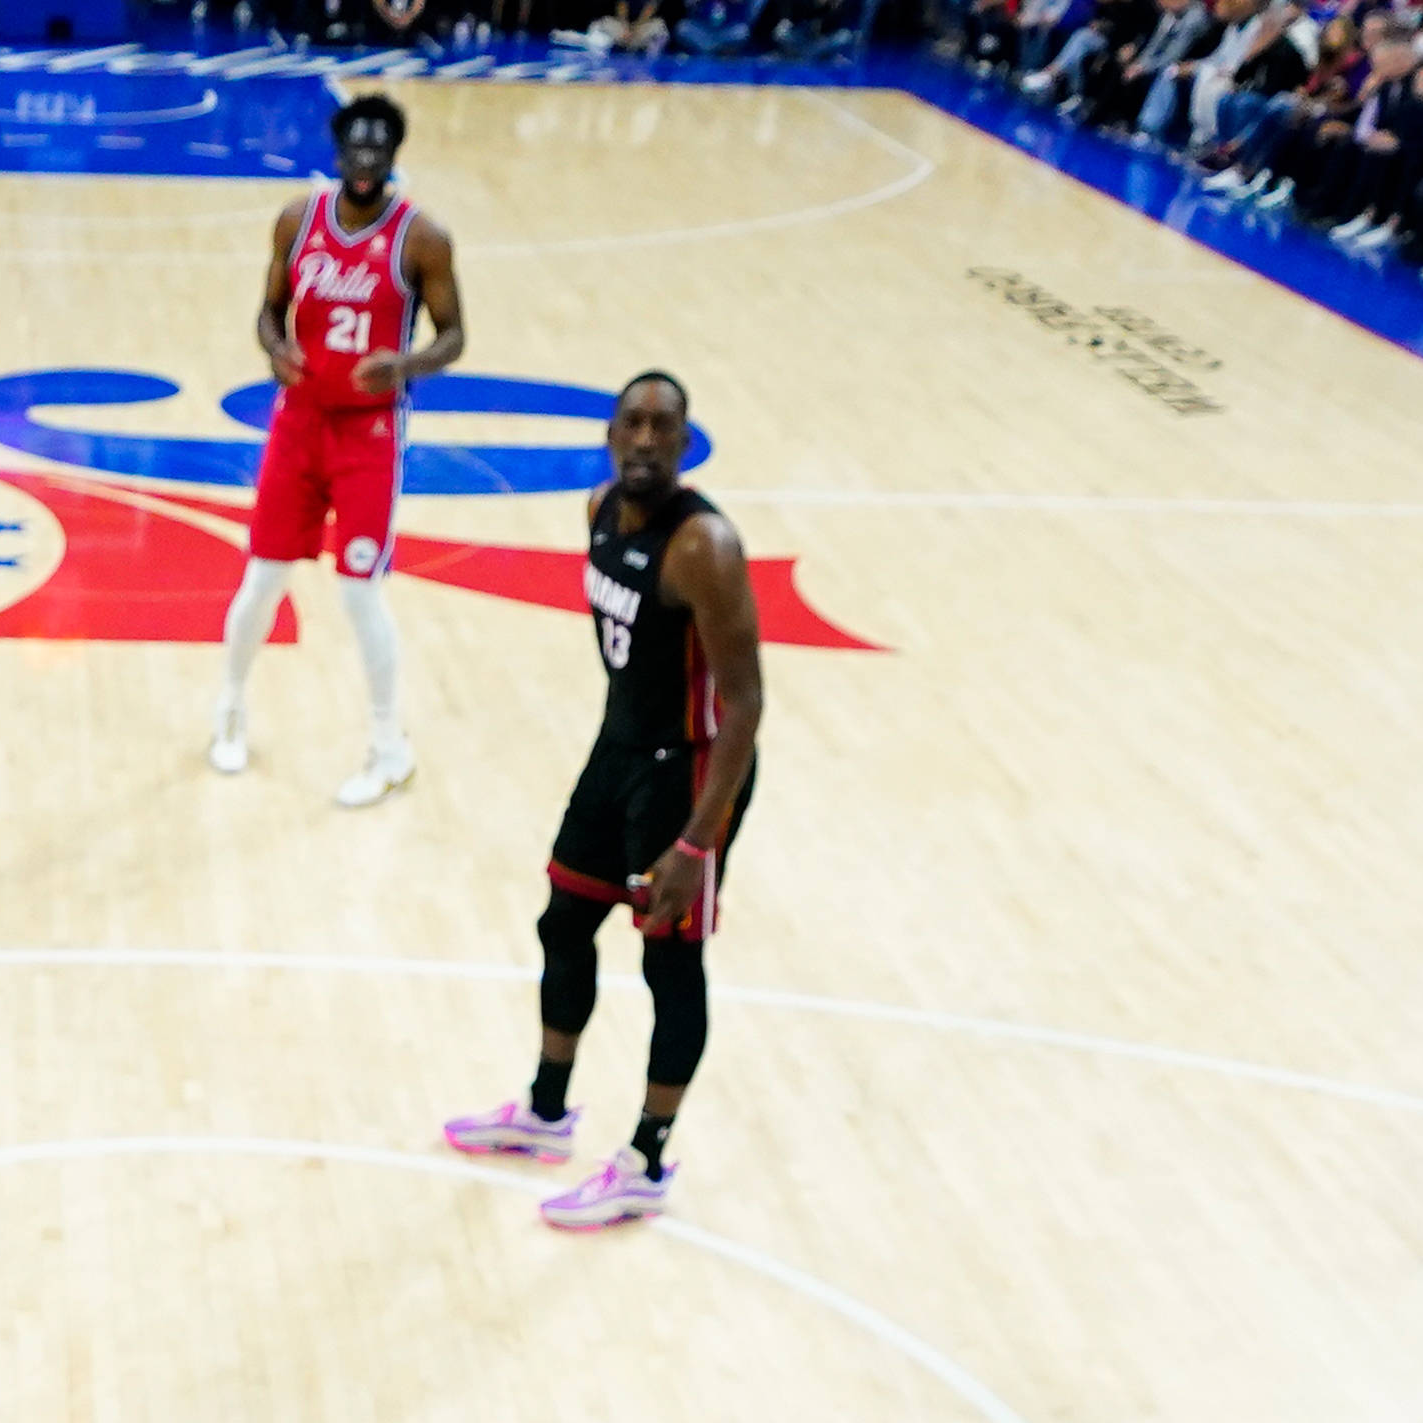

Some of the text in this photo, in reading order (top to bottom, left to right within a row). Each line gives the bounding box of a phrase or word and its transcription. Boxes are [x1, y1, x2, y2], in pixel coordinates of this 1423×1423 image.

[295, 251, 381, 304] Phila
[325, 305, 373, 354] 21
[600, 616, 632, 670] 13
